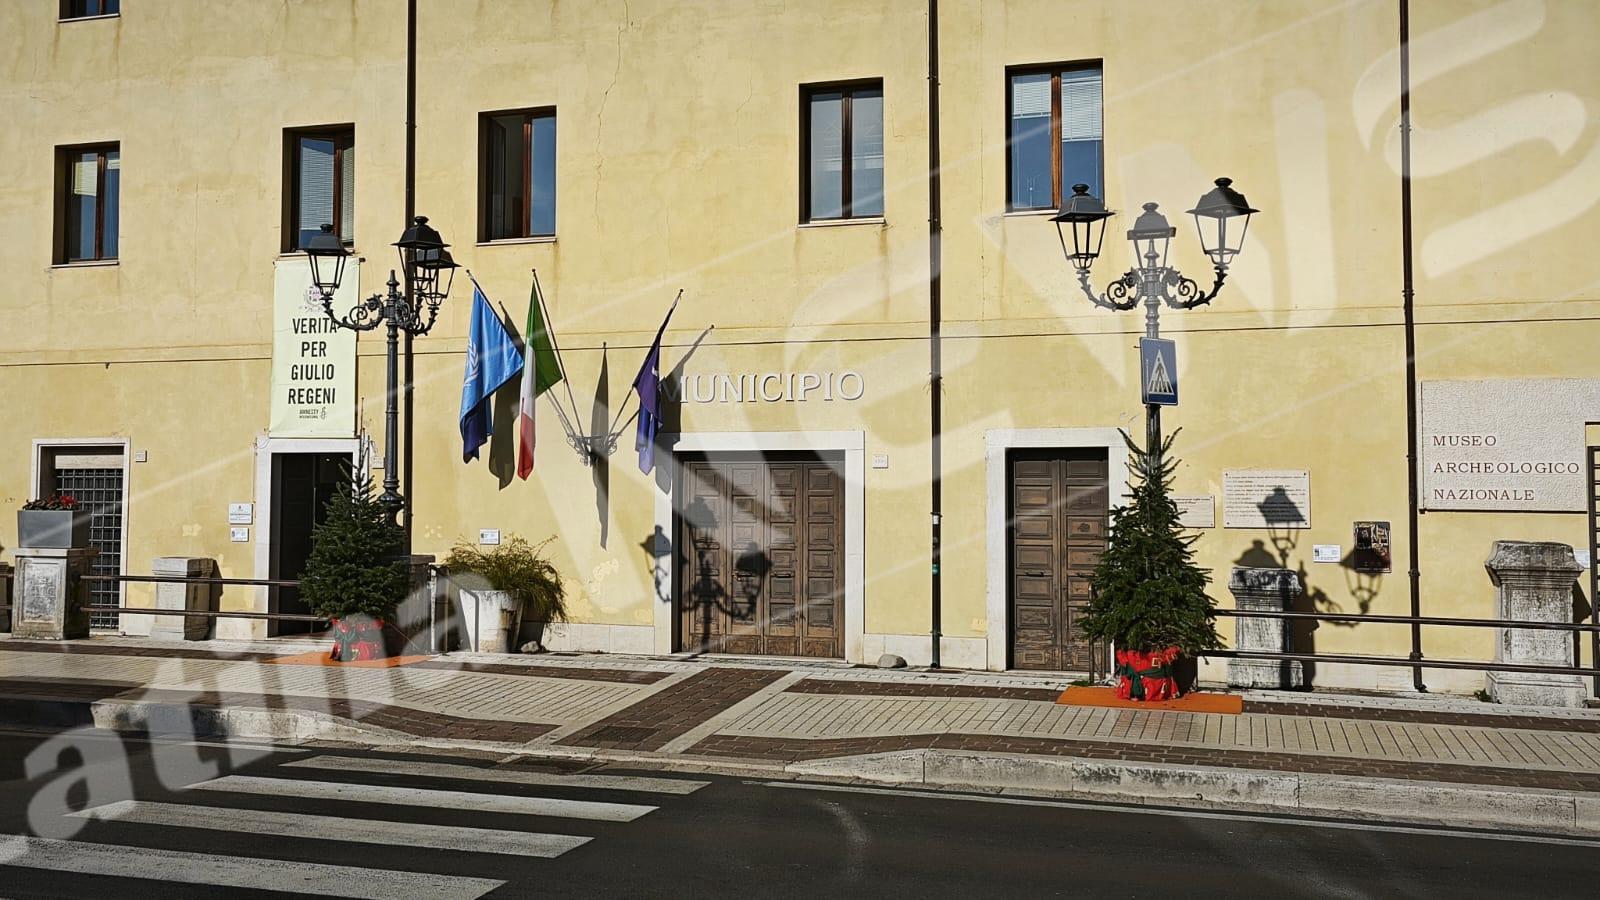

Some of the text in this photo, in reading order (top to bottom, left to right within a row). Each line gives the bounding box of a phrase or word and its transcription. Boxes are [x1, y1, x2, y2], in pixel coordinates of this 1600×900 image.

[301, 341, 327, 357] PER
[291, 363, 335, 381] GIULIO
[660, 371, 865, 404] MUNICIPIO
[288, 387, 336, 405] REGENI
[1433, 435, 1497, 447] MUSEO
[1433, 462, 1580, 474] ARCHEOLOGICO
[1434, 488, 1535, 501] NAZIONALE
